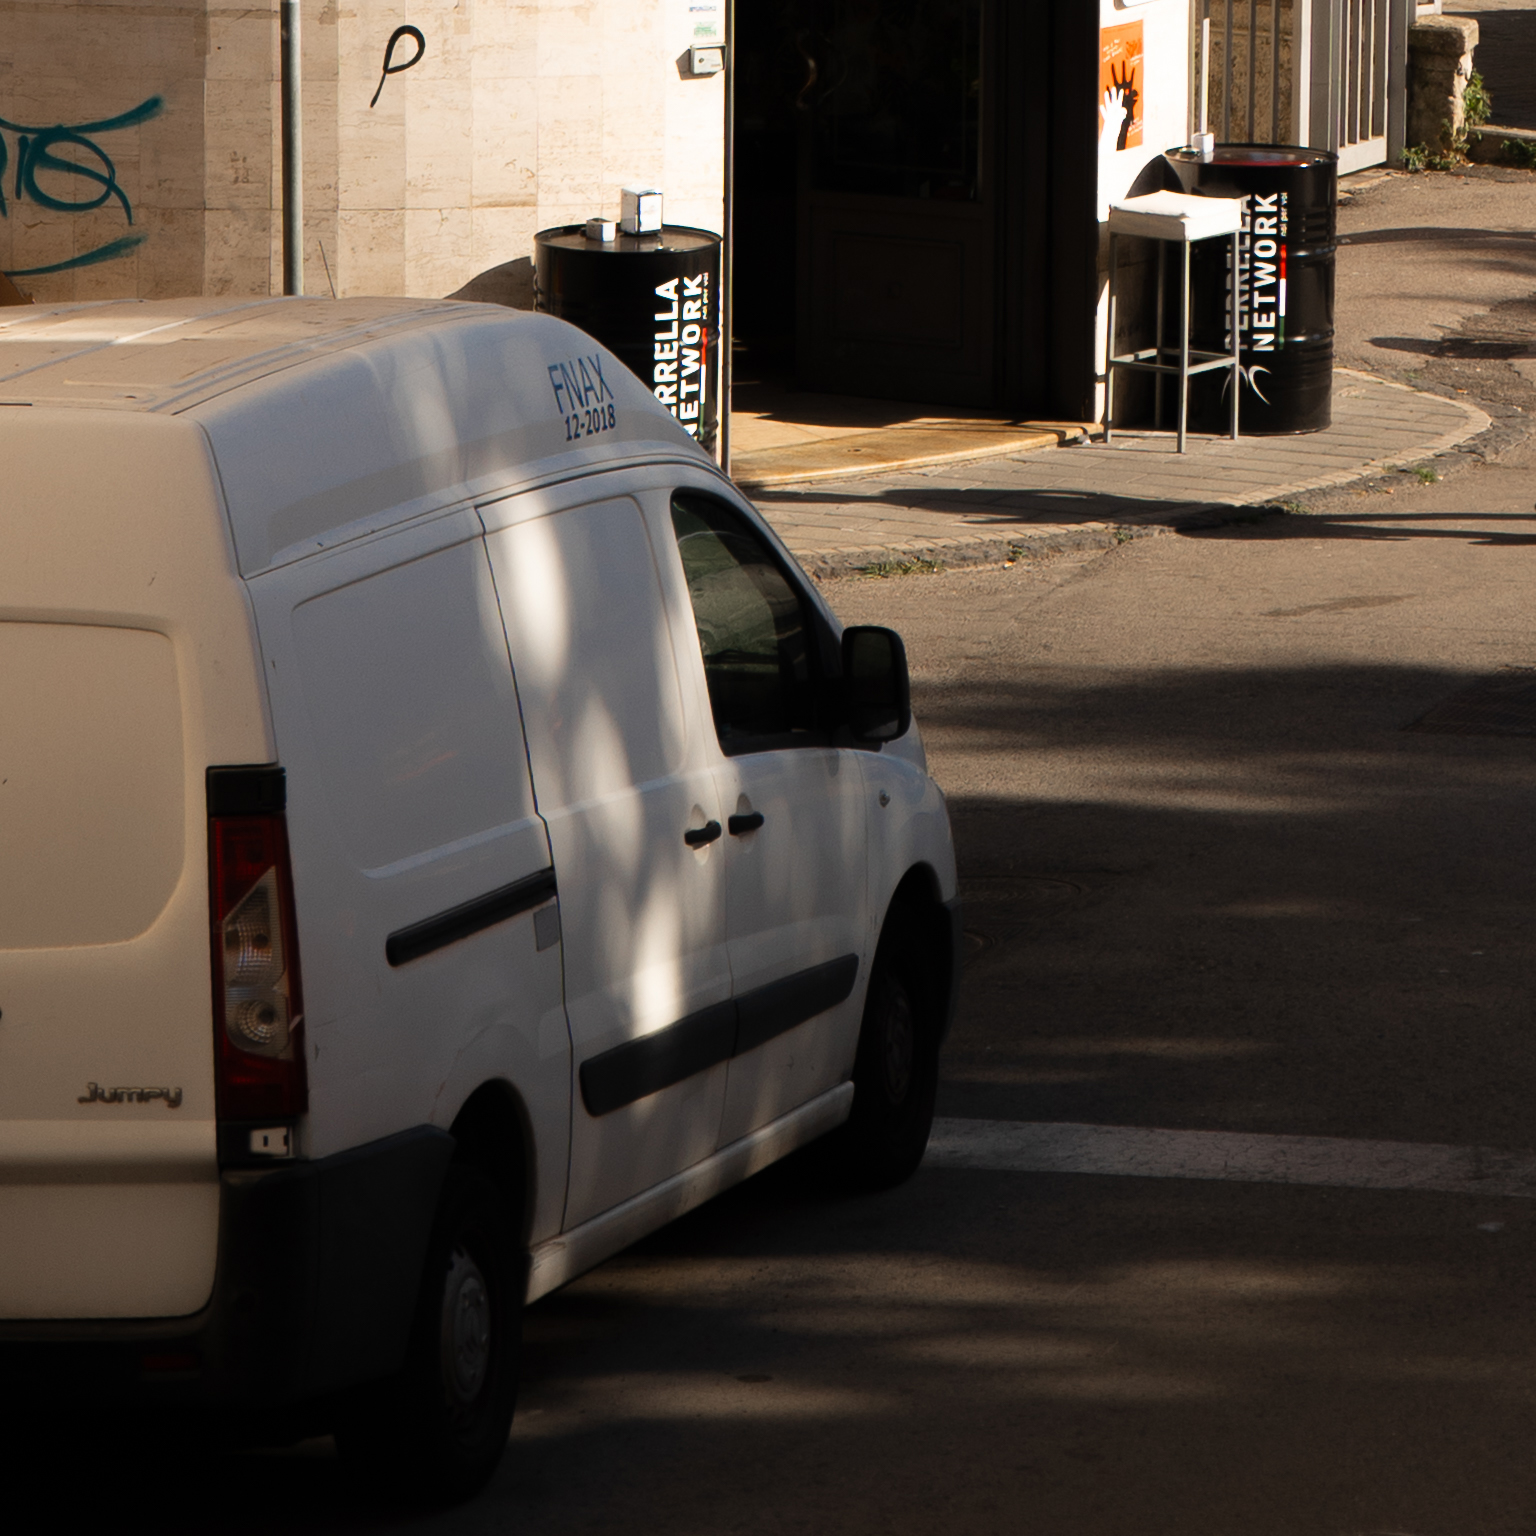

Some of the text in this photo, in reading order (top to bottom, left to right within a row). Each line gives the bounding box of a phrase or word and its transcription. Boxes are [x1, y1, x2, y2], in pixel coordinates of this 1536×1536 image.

[1252, 192, 1279, 352] NETWORK
[547, 353, 614, 415] FNAX
[564, 403, 617, 442] 12-2018
[78, 1082, 183, 1109] Jumpy
